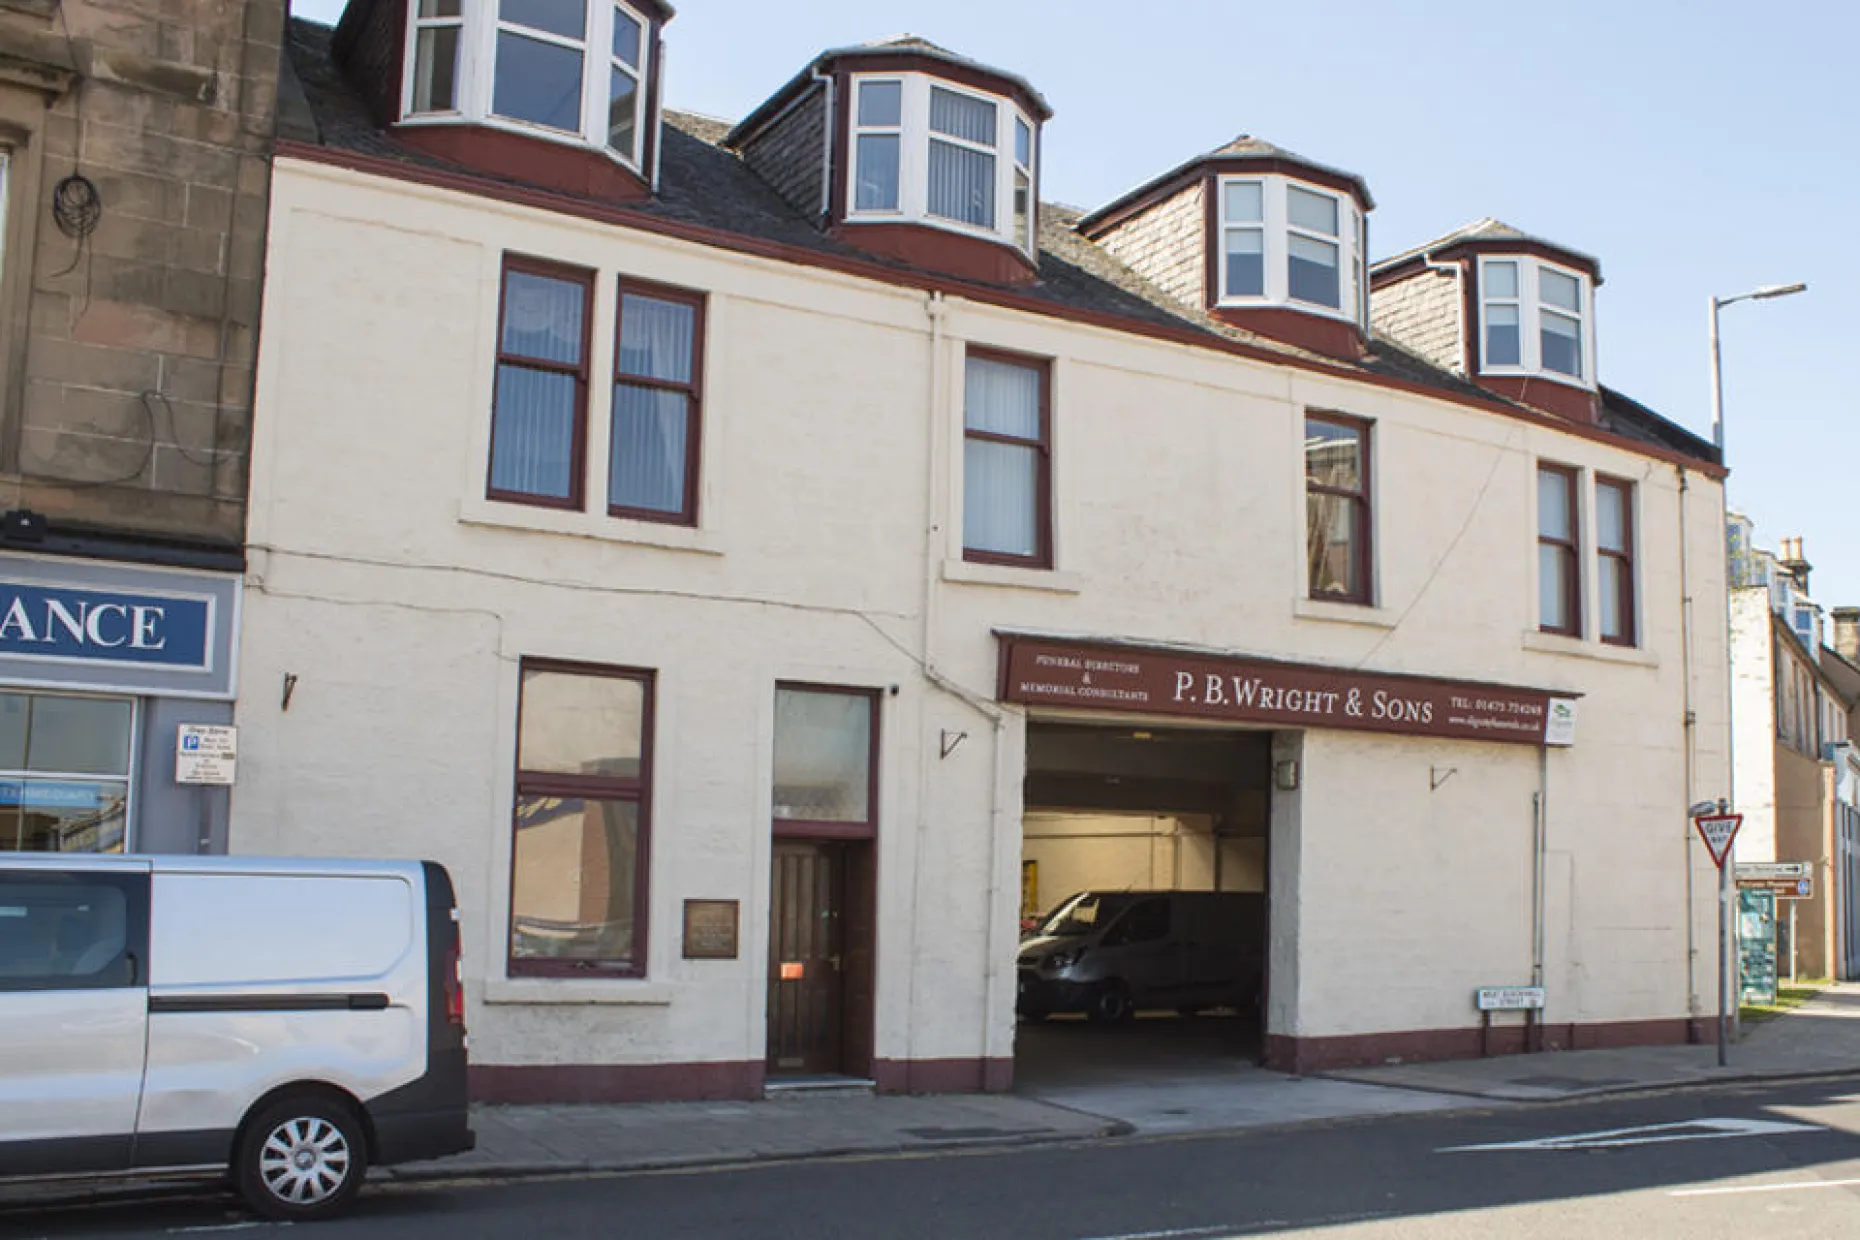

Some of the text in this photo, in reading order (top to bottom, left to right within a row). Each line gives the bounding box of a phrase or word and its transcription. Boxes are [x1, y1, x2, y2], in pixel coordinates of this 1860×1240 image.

[0, 596, 165, 650] ANCE
[1344, 687, 1364, 717] &
[1705, 821, 1732, 834] GIVE
